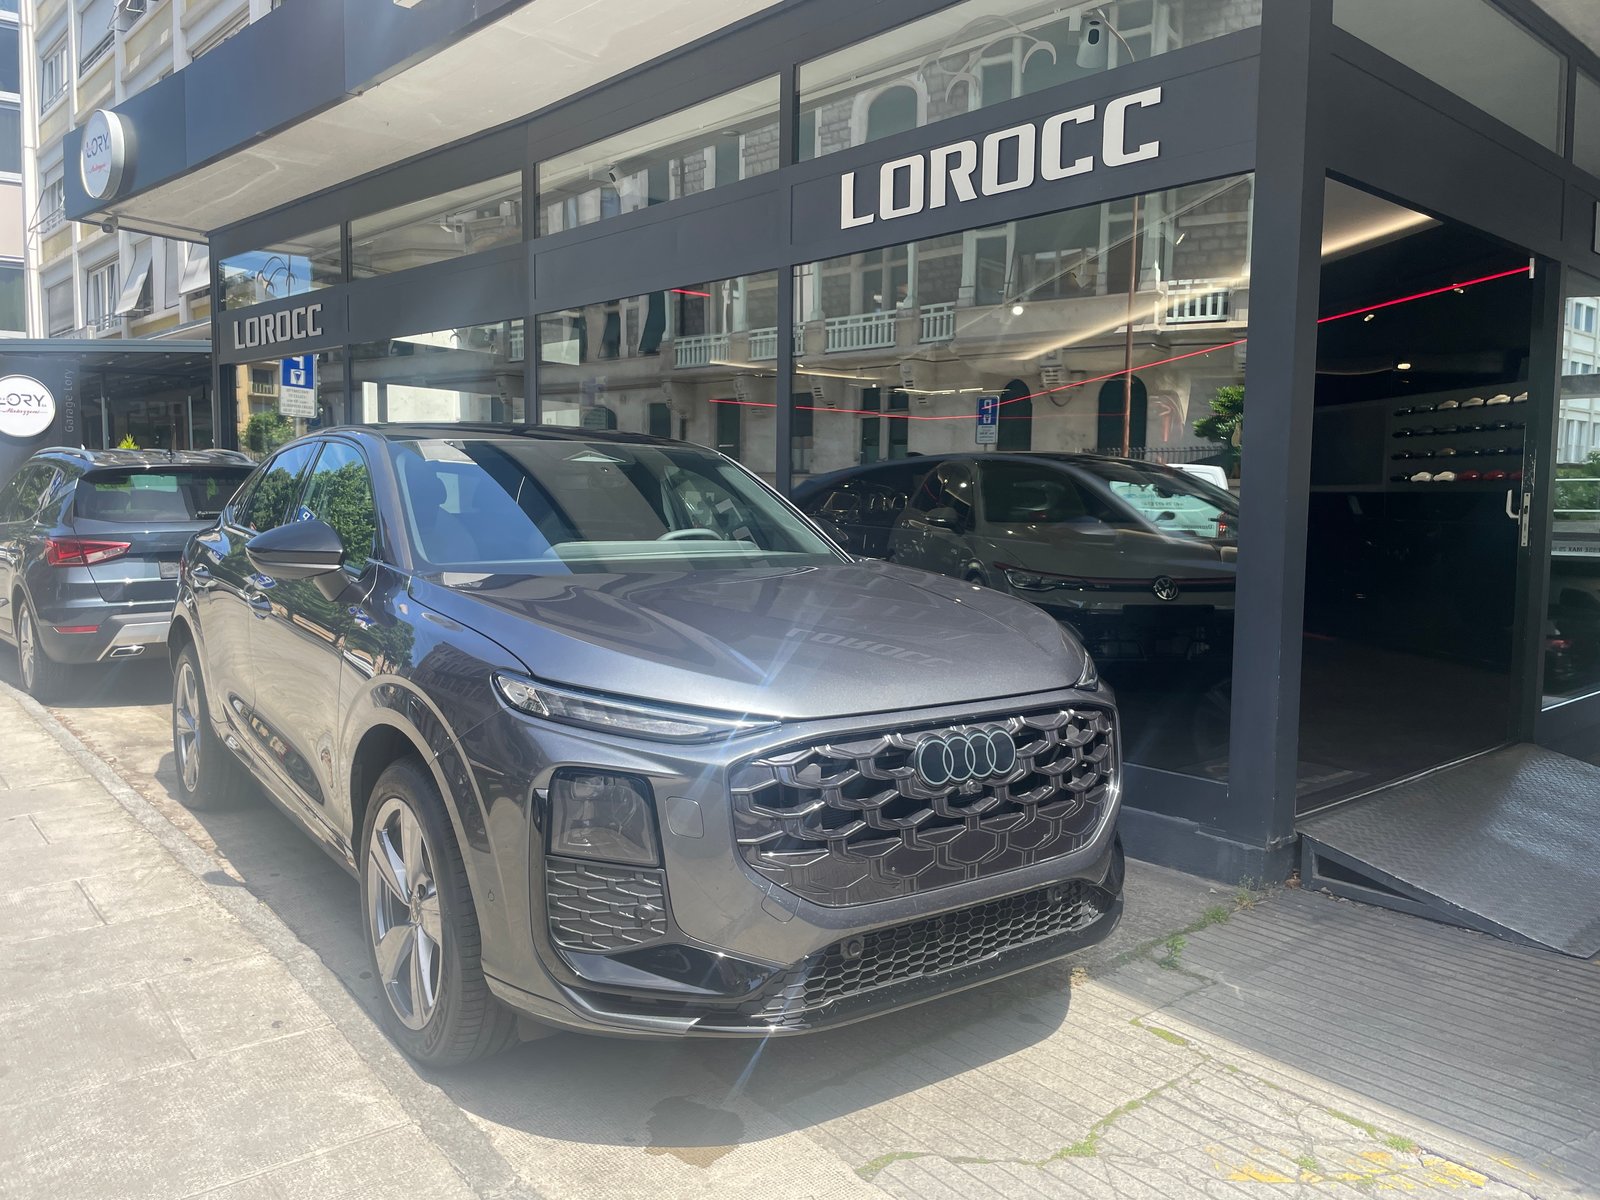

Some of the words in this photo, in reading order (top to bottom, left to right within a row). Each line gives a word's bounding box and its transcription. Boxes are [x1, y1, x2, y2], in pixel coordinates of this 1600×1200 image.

[86, 132, 108, 158] LORY
[841, 87, 1161, 229] LOROCC
[233, 303, 322, 349] LOROCC
[63, 368, 75, 391] Lory
[0, 393, 45, 407] ORY
[64, 395, 76, 433] Garage
